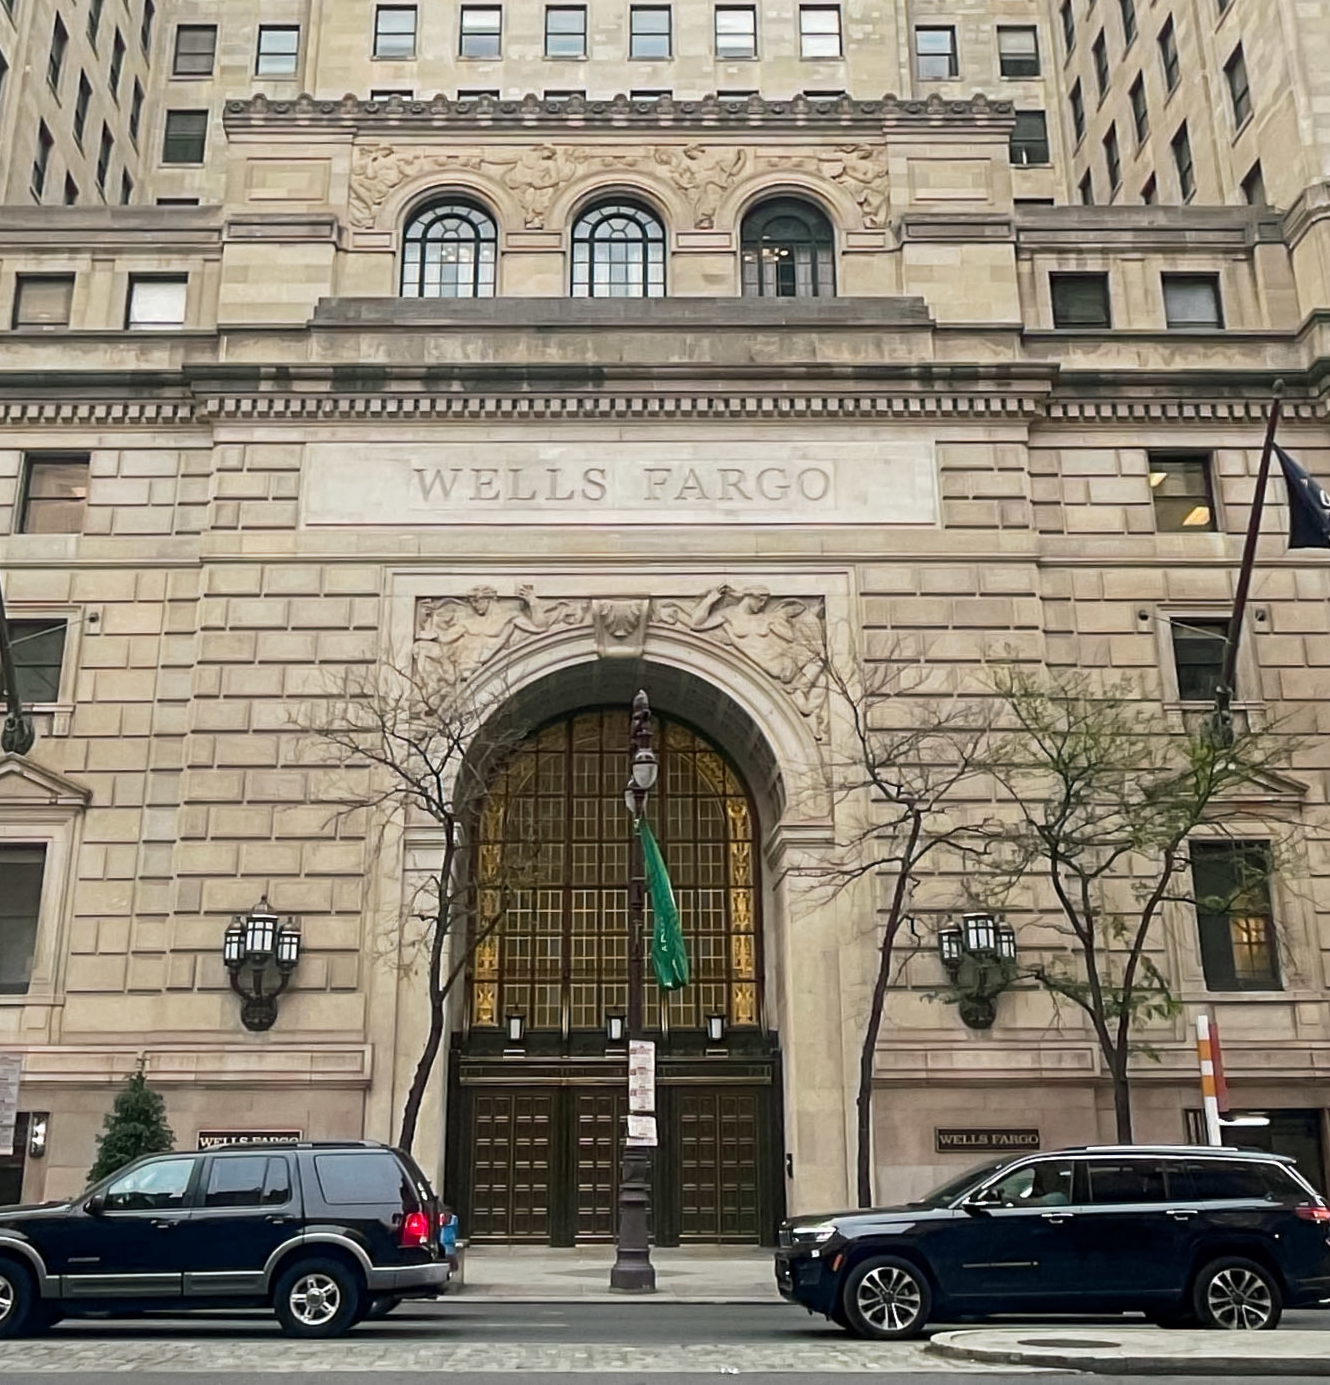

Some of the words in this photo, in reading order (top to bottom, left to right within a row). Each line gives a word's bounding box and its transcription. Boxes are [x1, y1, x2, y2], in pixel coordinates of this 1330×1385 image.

[413, 467, 608, 502] WELLS
[643, 467, 832, 502] FARGO
[940, 1134, 988, 1144] WELLS
[992, 1134, 1039, 1144] FARGO
